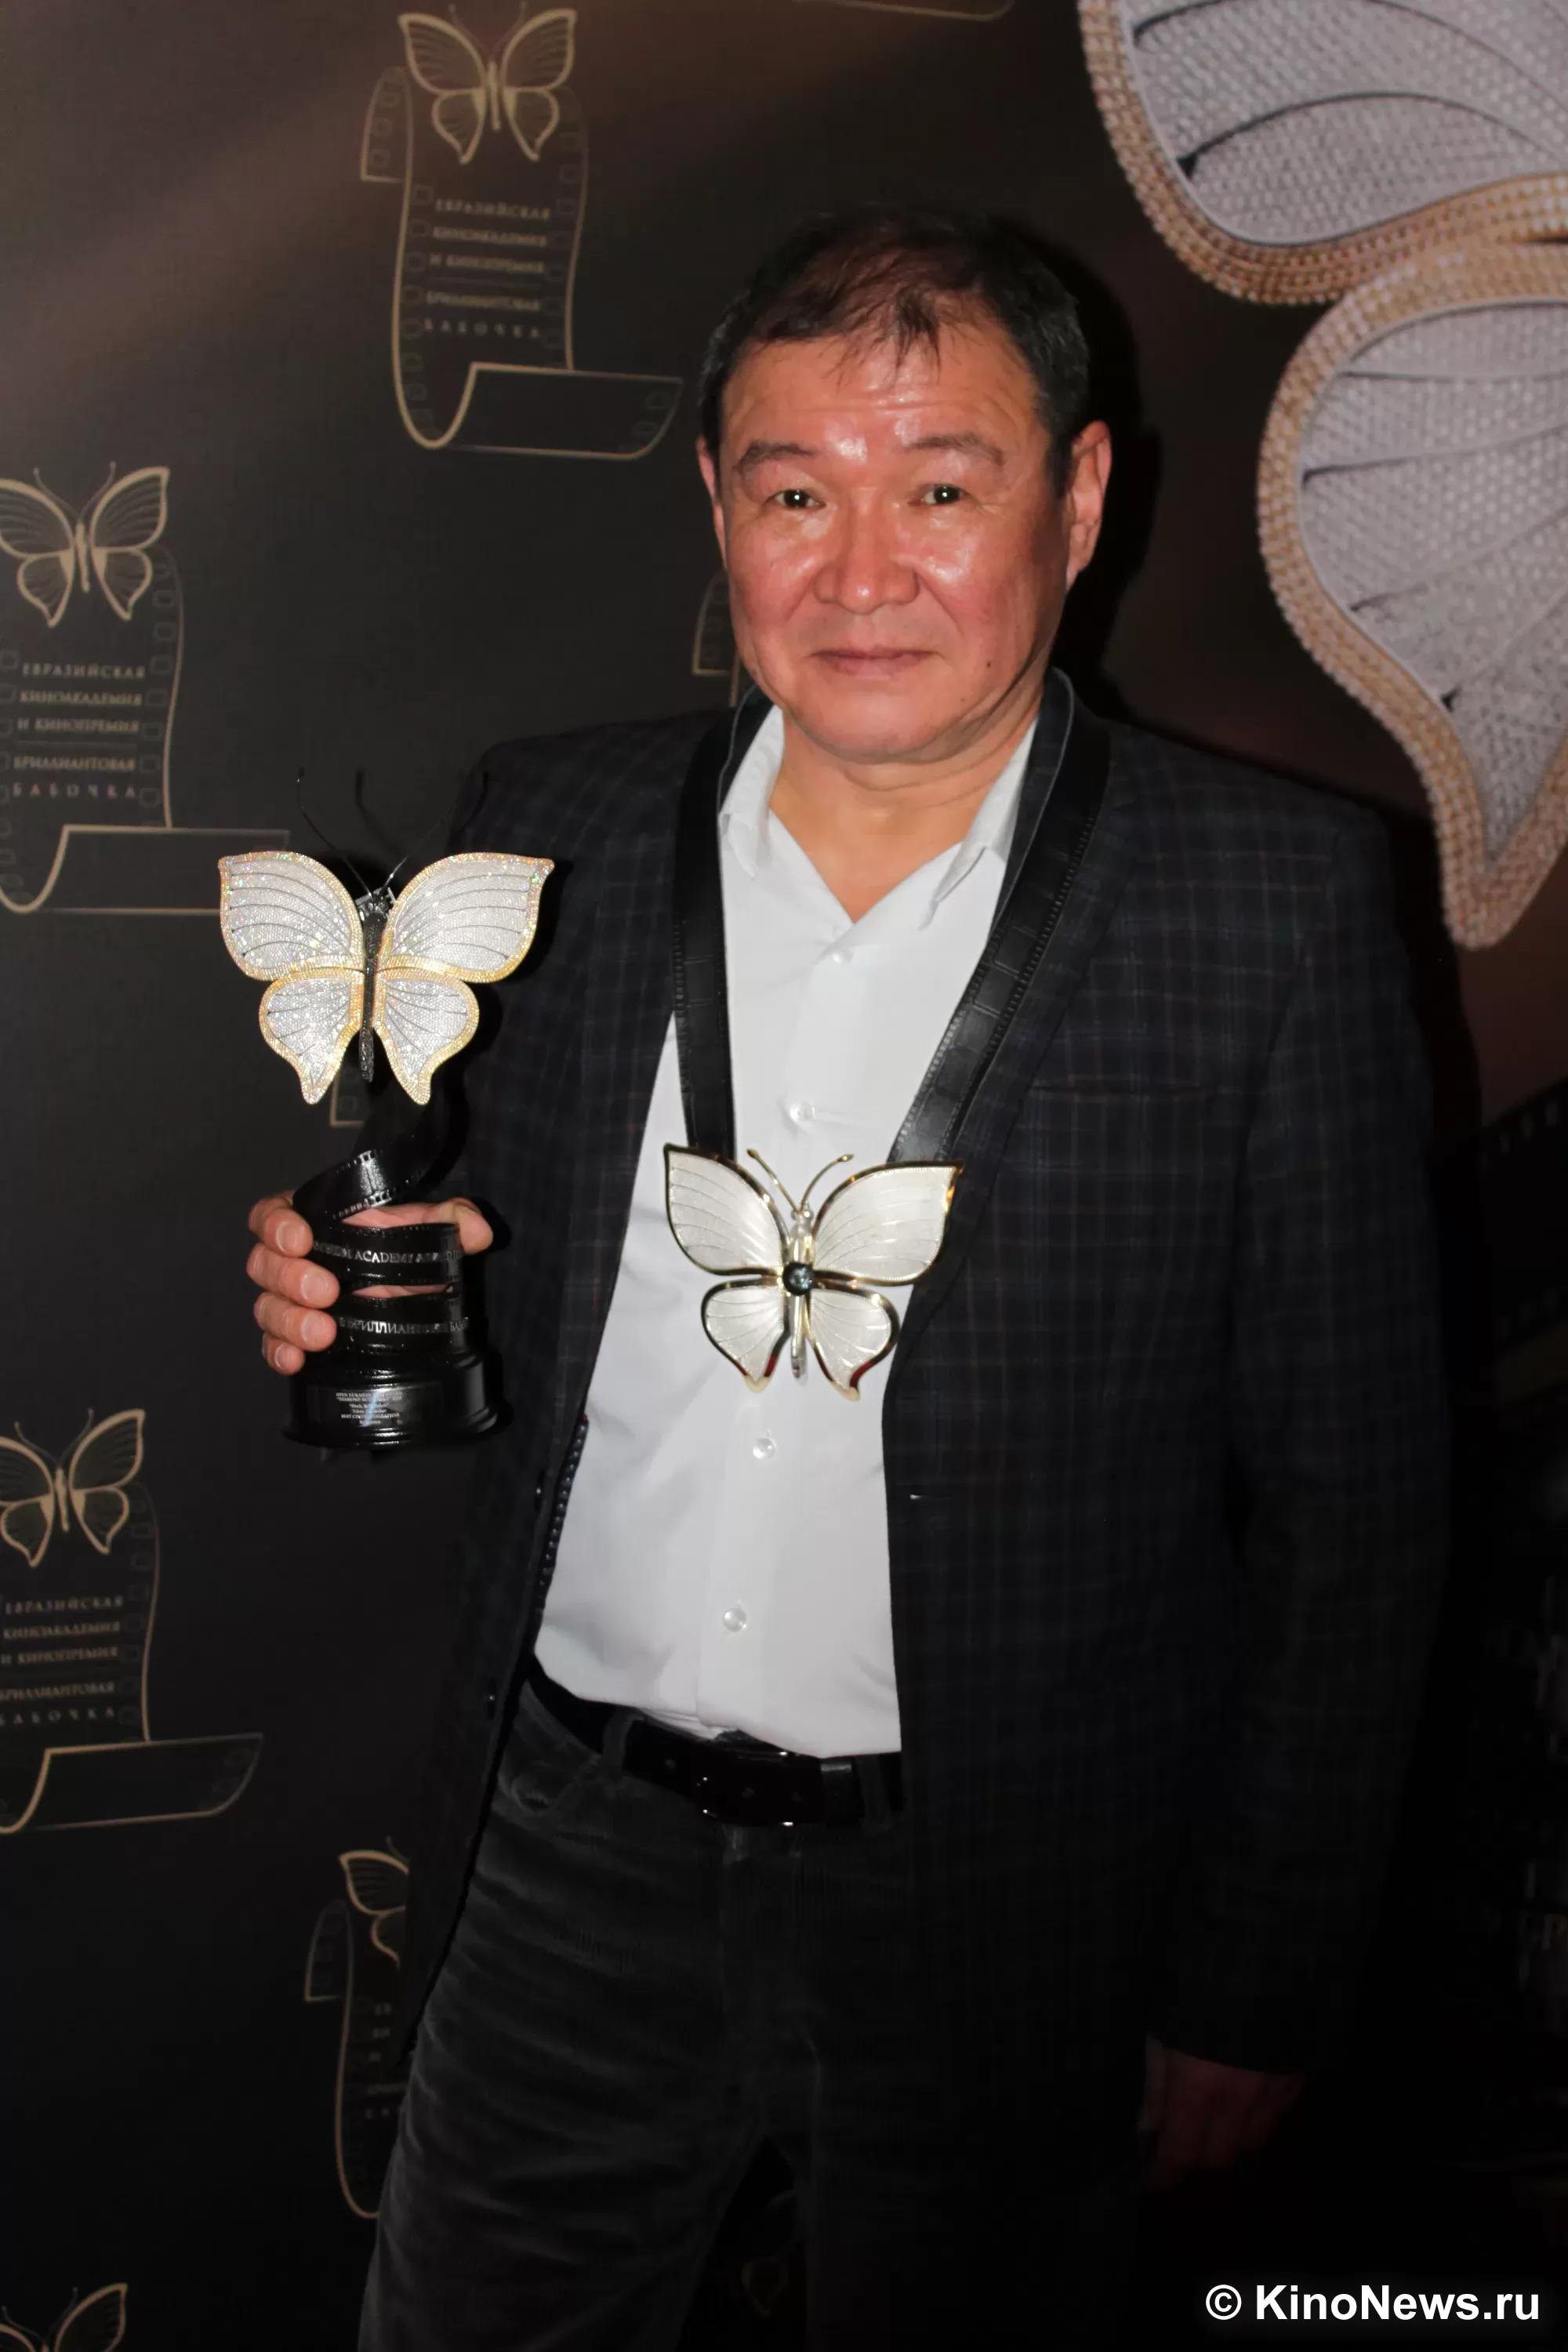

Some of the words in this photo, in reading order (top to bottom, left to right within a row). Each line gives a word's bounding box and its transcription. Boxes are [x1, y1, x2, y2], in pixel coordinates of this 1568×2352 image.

[22, 662, 146, 680] ЕВРАЗИЙСКАЯ
[19, 690, 143, 706] КИНОАКАДЕМИЯ
[17, 717, 30, 730] И
[34, 717, 140, 734] КИНОПРЕМИЯ
[13, 782, 136, 798] БАБОЧКА
[354, 1250, 413, 1263] ACADEMY
